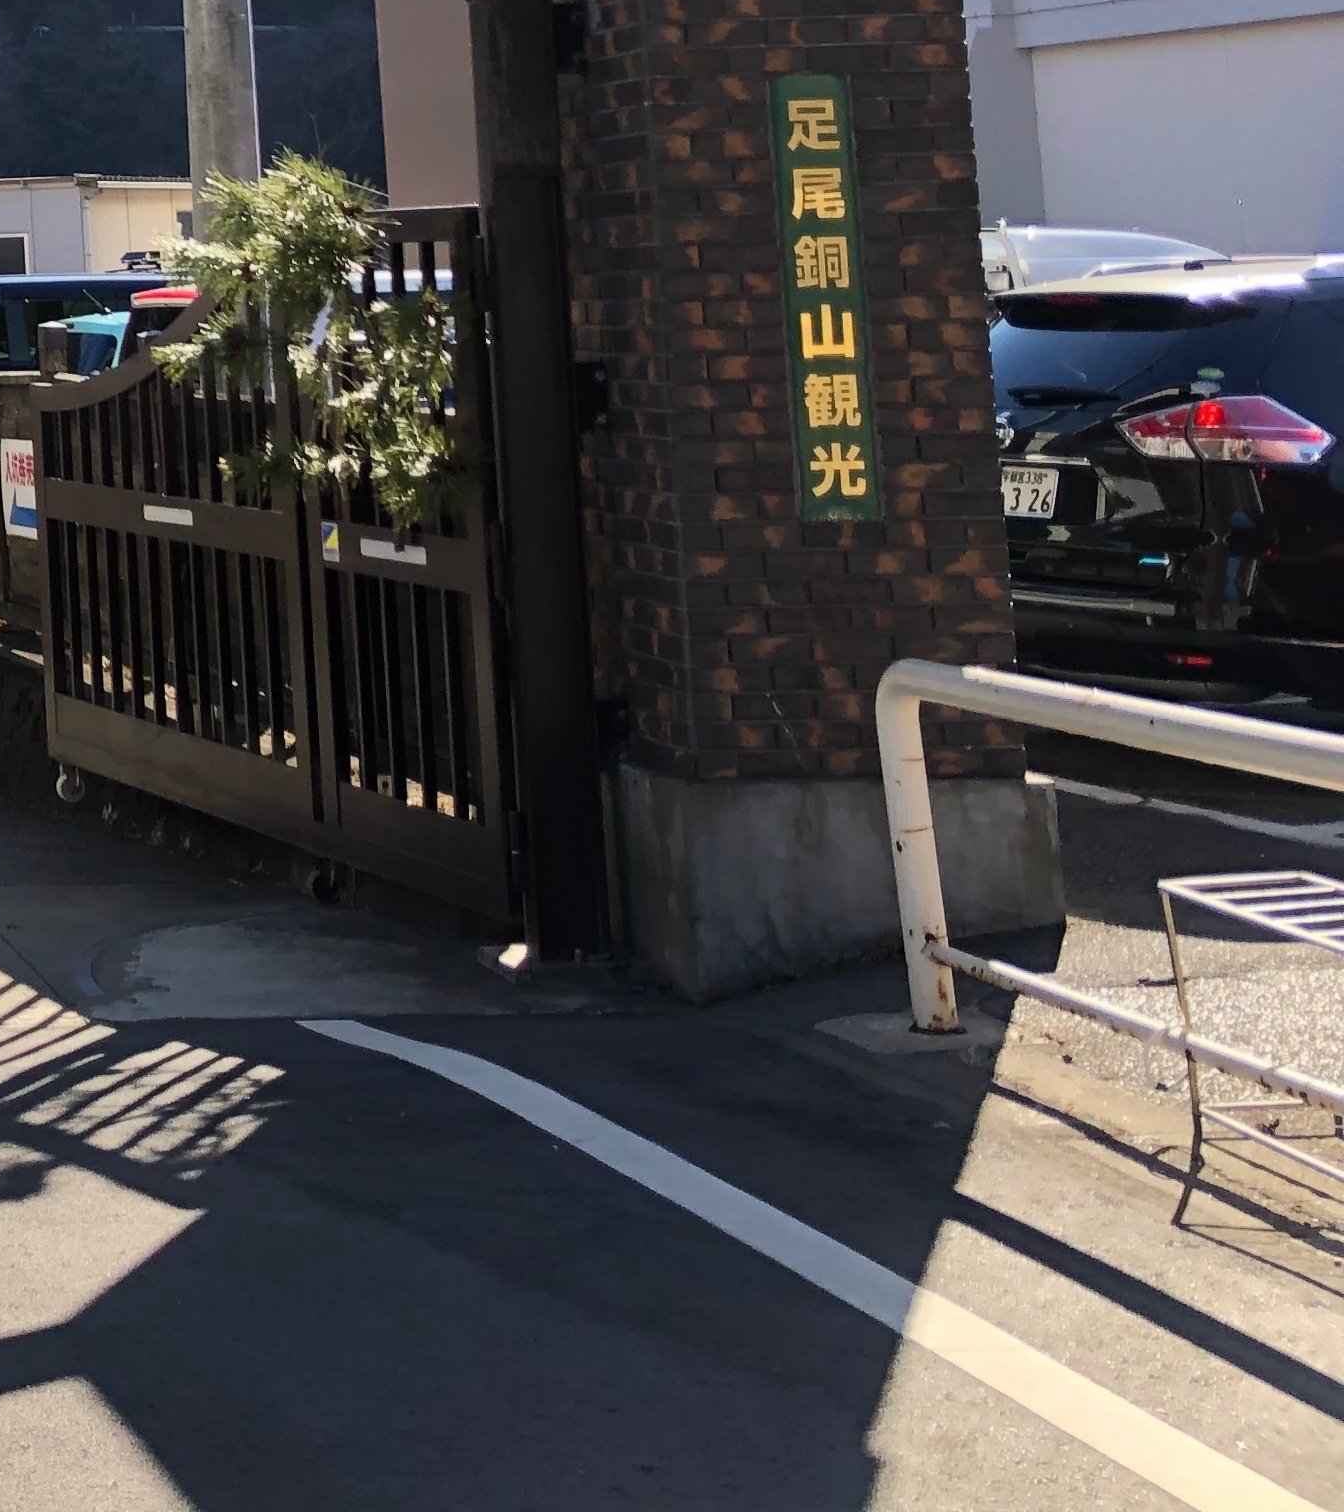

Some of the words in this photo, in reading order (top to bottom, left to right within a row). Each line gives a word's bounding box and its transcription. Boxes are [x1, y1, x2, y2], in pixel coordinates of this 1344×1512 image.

[786, 98, 867, 498] 足尾銅山観光
